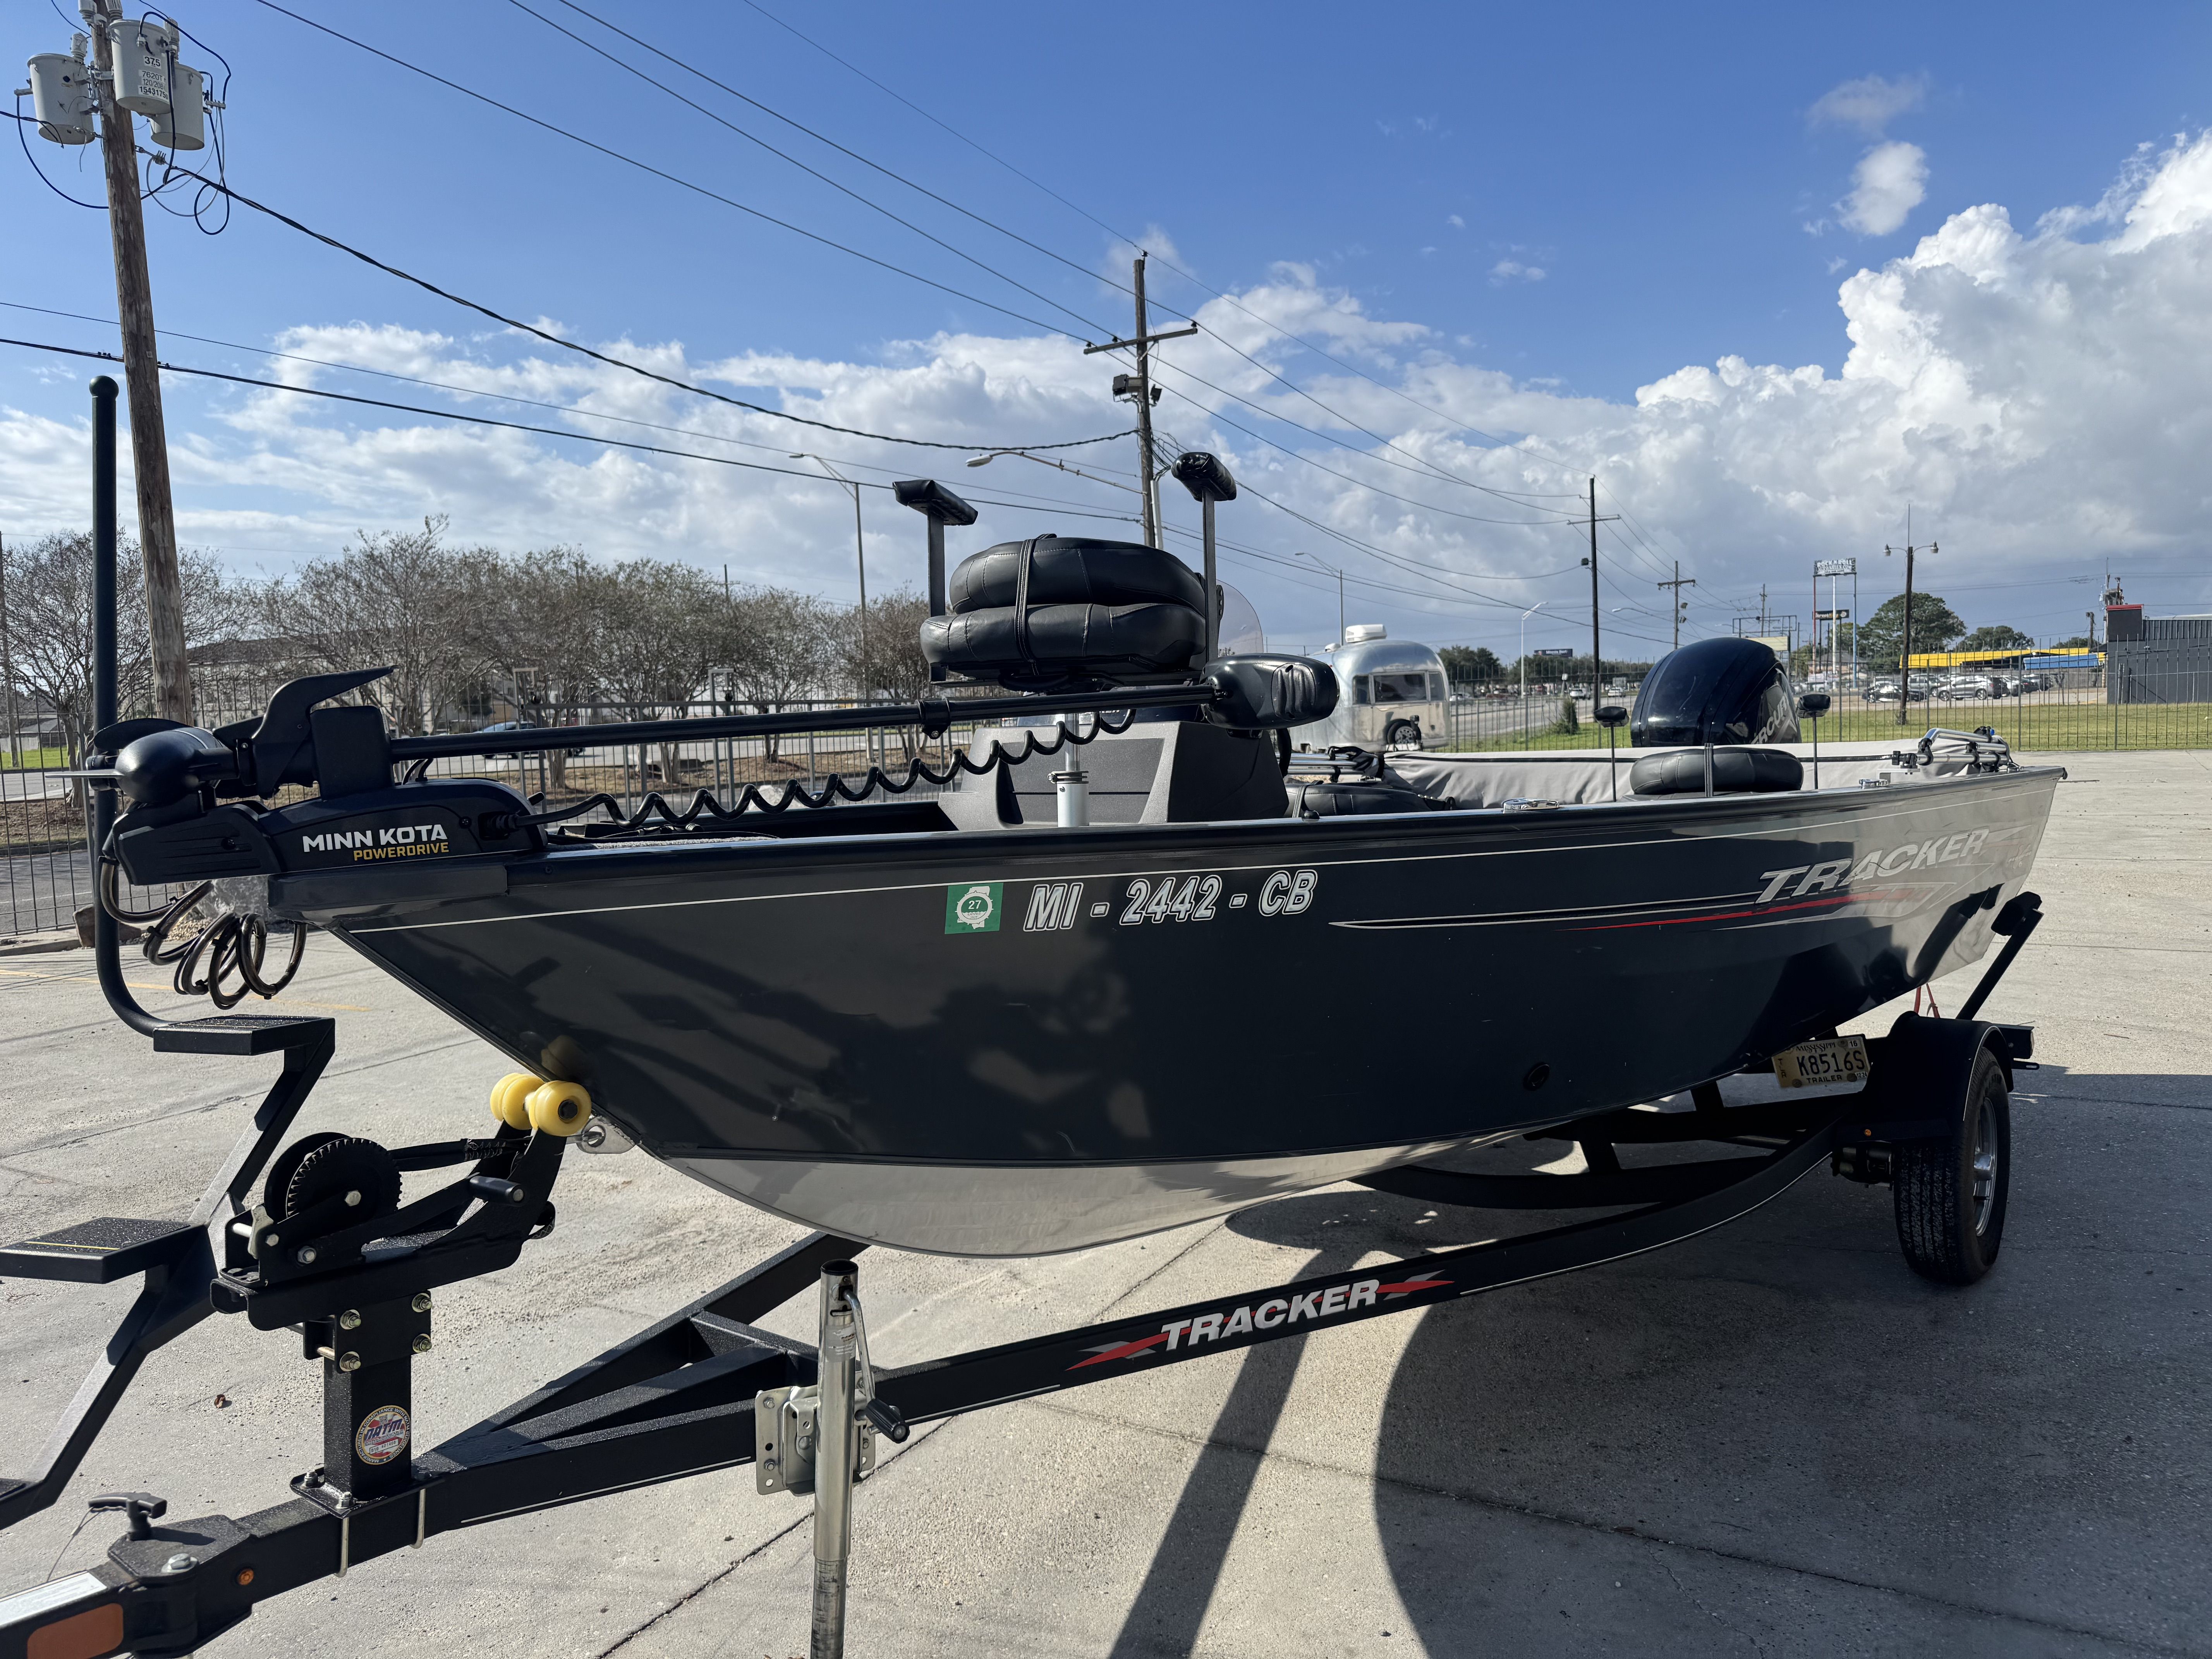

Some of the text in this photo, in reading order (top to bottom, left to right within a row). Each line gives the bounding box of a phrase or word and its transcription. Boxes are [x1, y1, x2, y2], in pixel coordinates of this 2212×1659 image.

[144, 57, 160, 67] 37.5
[302, 824, 447, 852] MINN KOTA
[354, 842, 449, 861] POWERDRIVE
[1755, 826, 1989, 904] TRACKER
[969, 900, 981, 909] 27
[1024, 883, 1084, 931] MI
[1120, 875, 1222, 925] 2442
[1259, 869, 1317, 917] CB
[1796, 1050, 1865, 1076] K8516S
[1806, 1075, 1842, 1084] TRAILER
[1161, 1279, 1380, 1352] TRACKER
